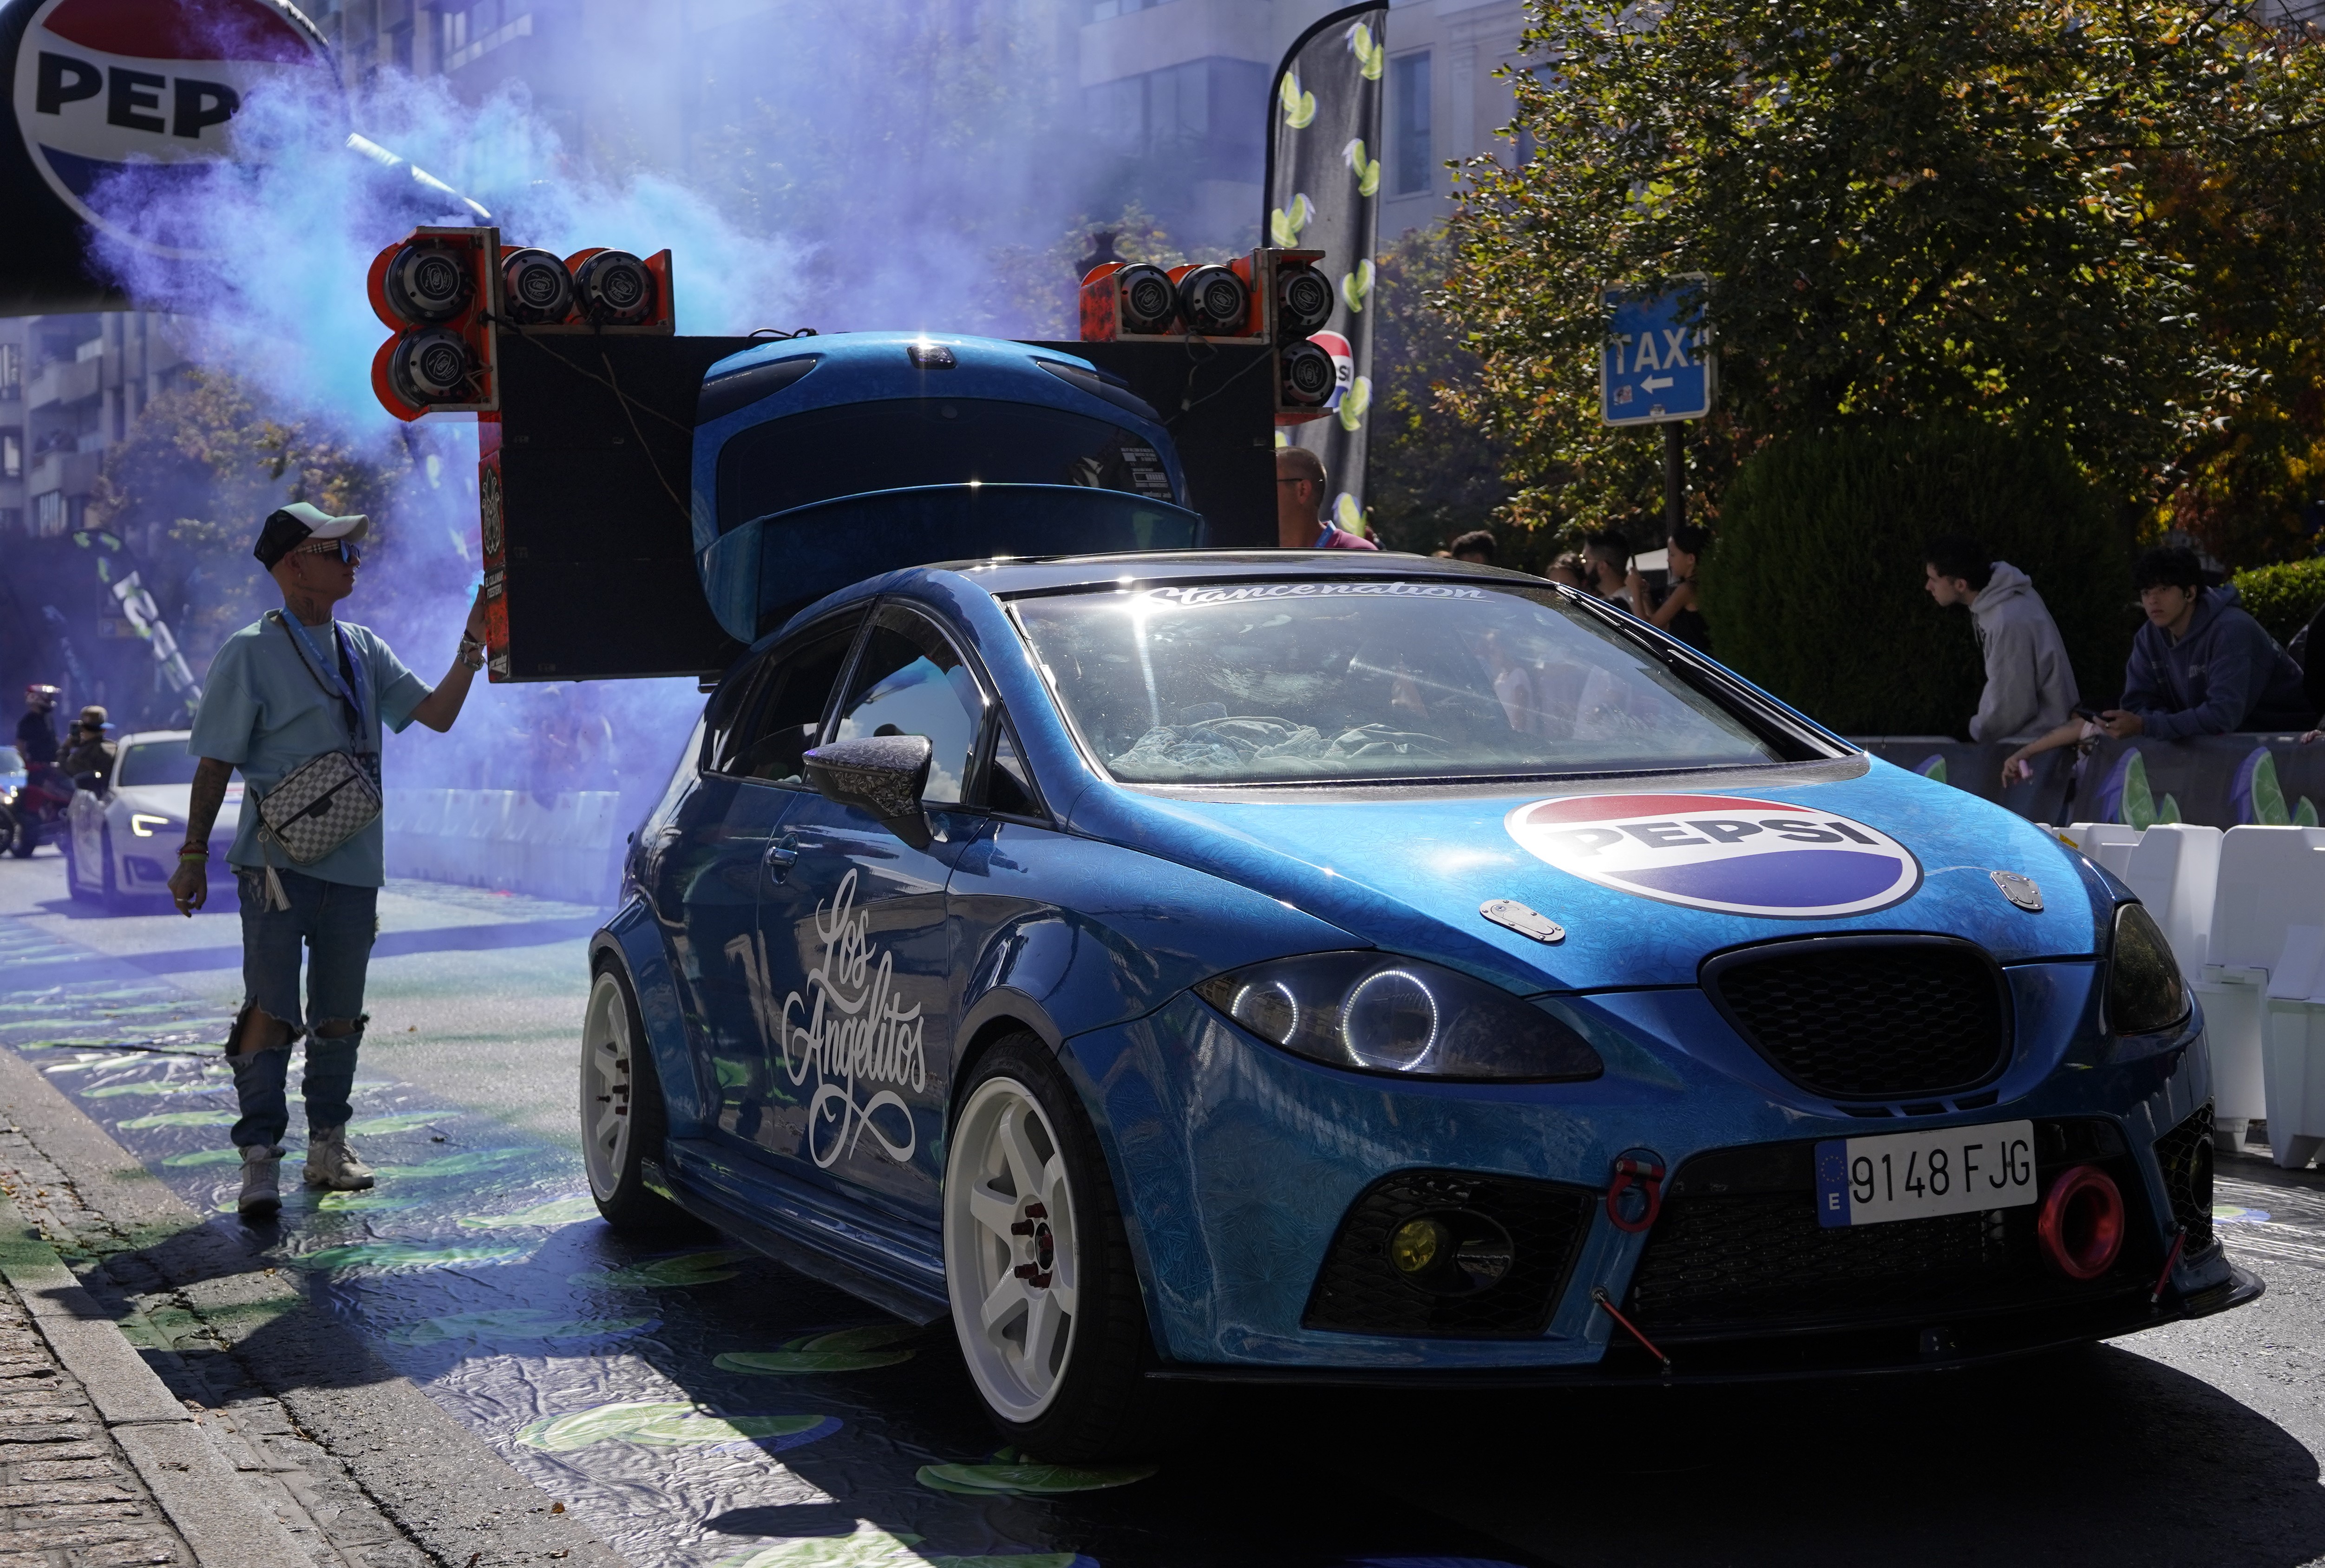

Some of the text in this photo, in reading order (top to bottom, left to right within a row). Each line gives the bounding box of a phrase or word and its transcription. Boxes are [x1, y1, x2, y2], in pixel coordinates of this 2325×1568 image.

[36, 51, 241, 139] PEP
[1544, 819, 1880, 856] PEPSI
[806, 868, 876, 1014] Los
[781, 950, 926, 1169] Angelitos
[1828, 1193, 1840, 1210] E
[1852, 1139, 2030, 1203] 9148 FJG
